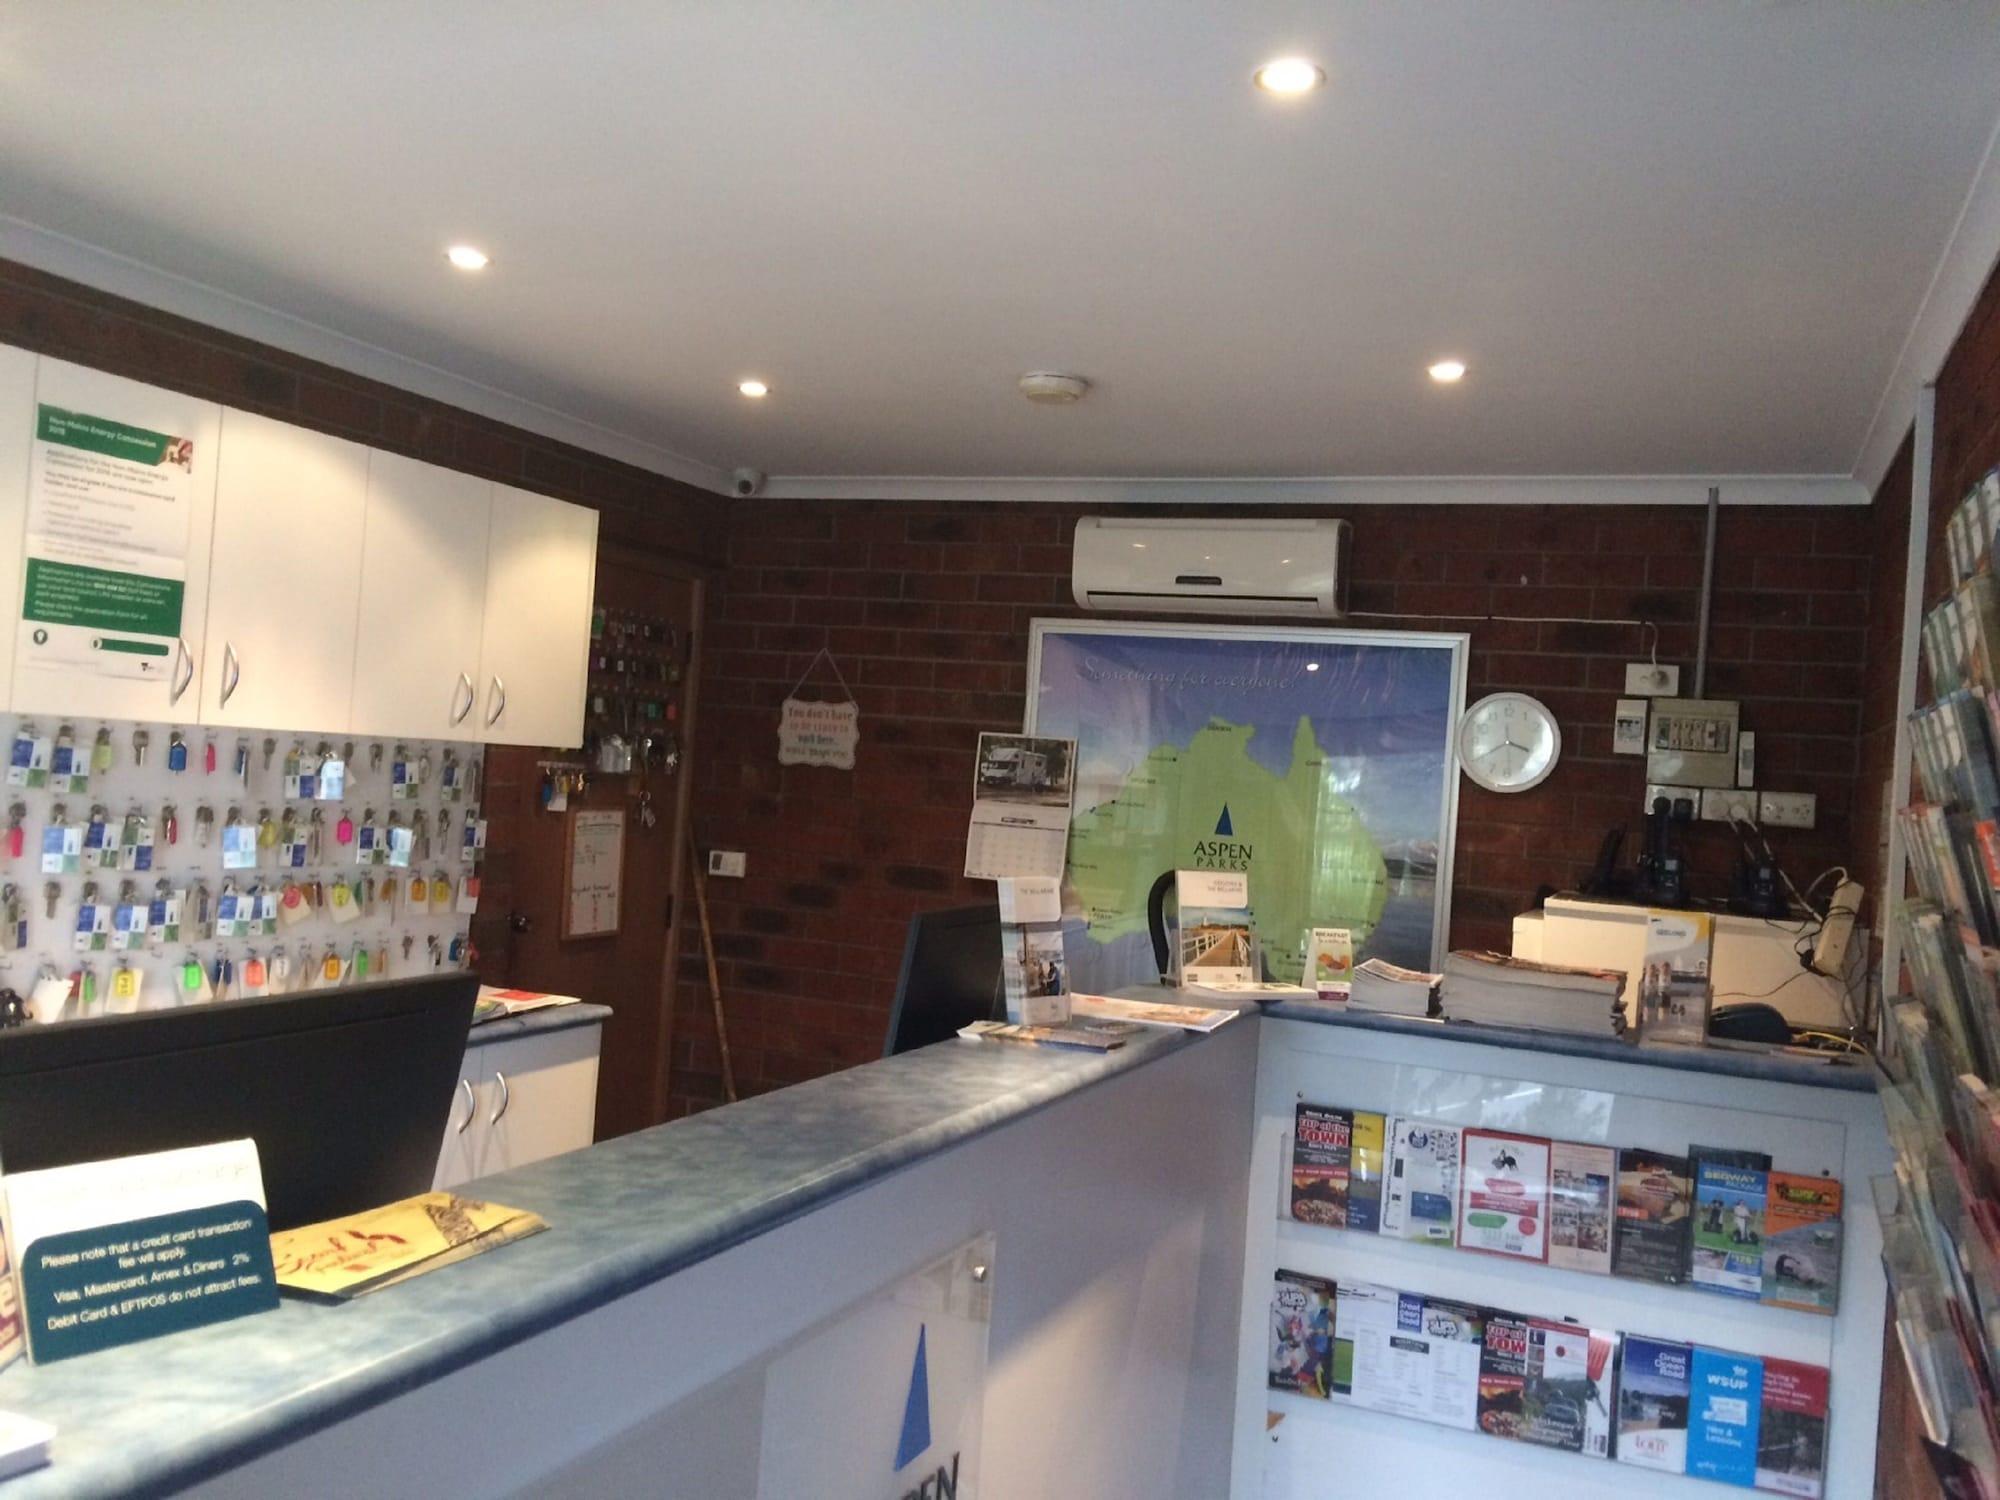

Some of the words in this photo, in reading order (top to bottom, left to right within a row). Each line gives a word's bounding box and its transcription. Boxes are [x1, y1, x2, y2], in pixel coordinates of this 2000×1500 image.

[91, 426, 116, 440] Energy
[1193, 840, 1253, 861] ASPEN
[1196, 857, 1249, 872] PARKS
[1298, 1127, 1350, 1149] TOWN
[1704, 1170, 1757, 1183] SEGWAY
[41, 1253, 79, 1269] Please
[81, 1247, 106, 1261] note
[108, 1241, 130, 1256] that
[132, 1242, 140, 1252] a
[141, 1233, 171, 1249] credit
[172, 1229, 197, 1242] card
[197, 1219, 252, 1238] transaction
[118, 1256, 136, 1270] fee
[137, 1252, 155, 1265] will
[151, 1269, 181, 1284] Amex
[183, 1264, 192, 1277] &
[192, 1259, 226, 1275] Diners
[48, 1313, 79, 1331] Debit
[80, 1305, 108, 1323] Card
[110, 1304, 119, 1316] &
[121, 1293, 167, 1315] EFTPOS
[169, 1290, 183, 1303] do
[185, 1286, 203, 1300] not
[204, 1279, 237, 1296] attract
[1654, 1359, 1686, 1372] Ocean
[1658, 1352, 1686, 1365] Great
[1659, 1367, 1685, 1379] Road
[1706, 1373, 1748, 1389] WSUP
